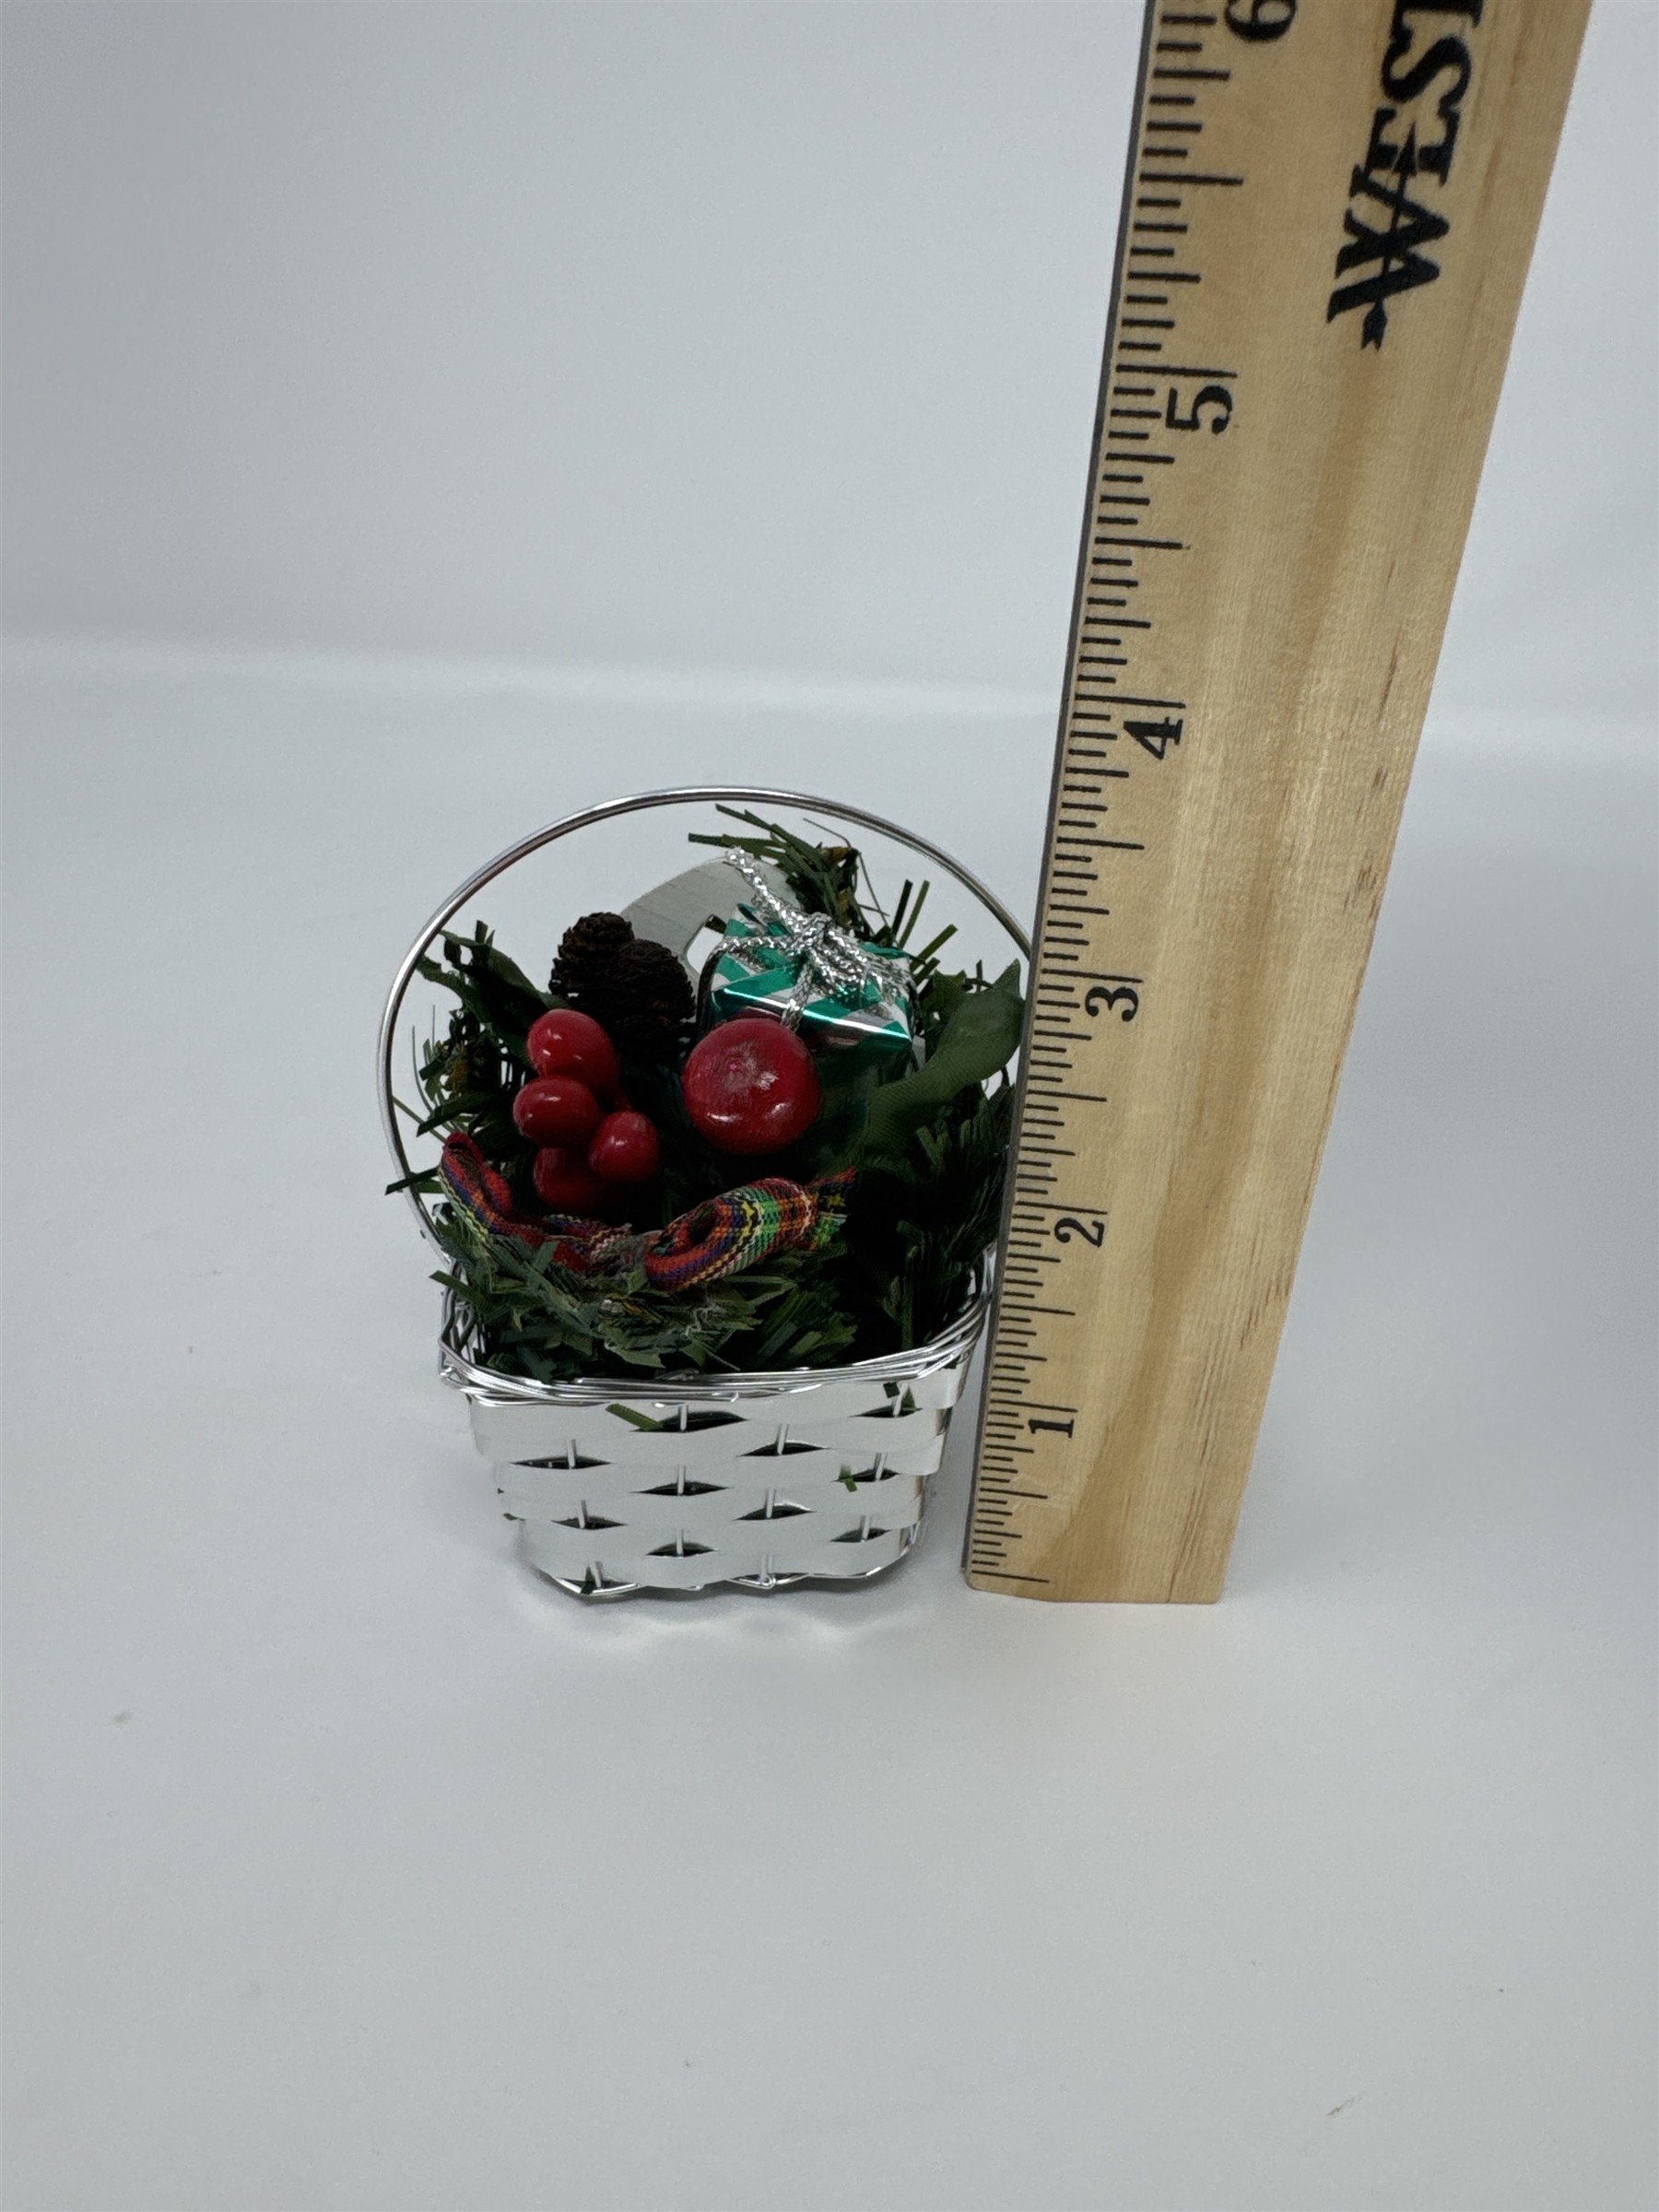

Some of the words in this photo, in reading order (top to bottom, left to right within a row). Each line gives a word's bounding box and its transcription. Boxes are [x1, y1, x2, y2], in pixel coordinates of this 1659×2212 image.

[1224, 0, 1297, 42] 6
[1165, 385, 1233, 435] 5
[1123, 716, 1183, 760] 4
[1084, 986, 1139, 1022] 3
[1053, 1218, 1105, 1248] 2
[1028, 1418, 1075, 1439] 1
